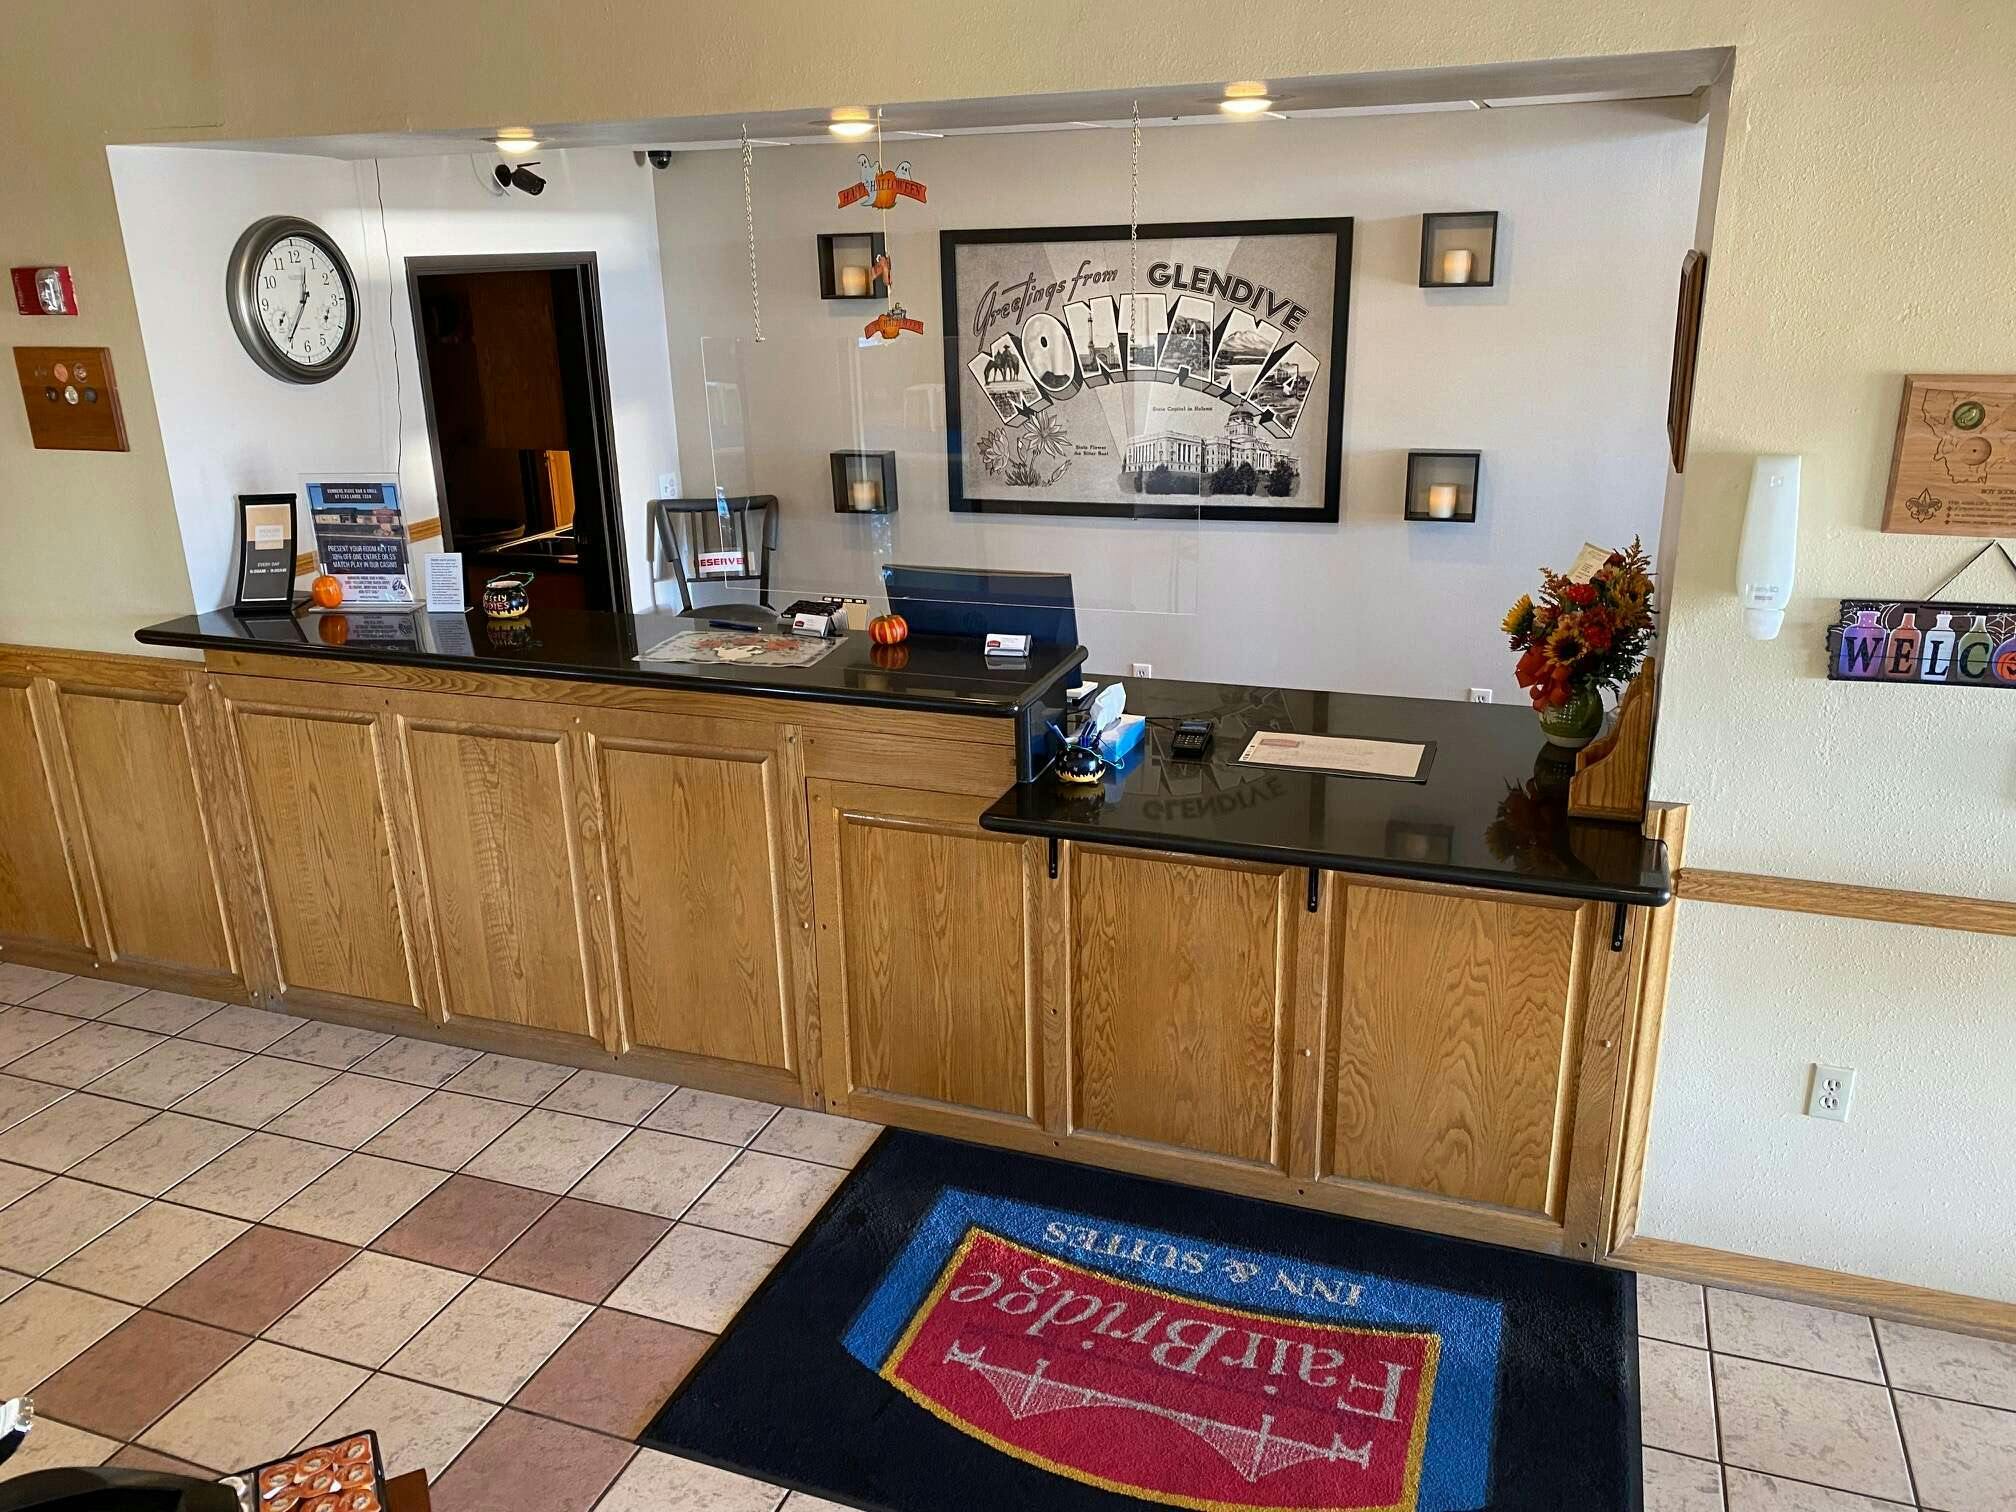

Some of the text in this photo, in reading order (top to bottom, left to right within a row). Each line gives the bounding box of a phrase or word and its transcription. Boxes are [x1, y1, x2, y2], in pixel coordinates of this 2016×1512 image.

[288, 250, 301, 263] 12
[274, 258, 285, 270] 11
[310, 258, 317, 269] 1
[264, 276, 277, 289] 10
[322, 273, 329, 285] 2
[331, 294, 338, 307] 3
[1146, 261, 1310, 334] GLENDIVE
[262, 298, 269, 311] 9
[972, 260, 1119, 352] Greetings from
[304, 340, 311, 352] 6
[320, 334, 327, 346] 5
[967, 293, 1320, 439] MONTANA
[1043, 1221, 1367, 1308] INN & SUITES
[950, 1267, 1414, 1421] FairBridge
